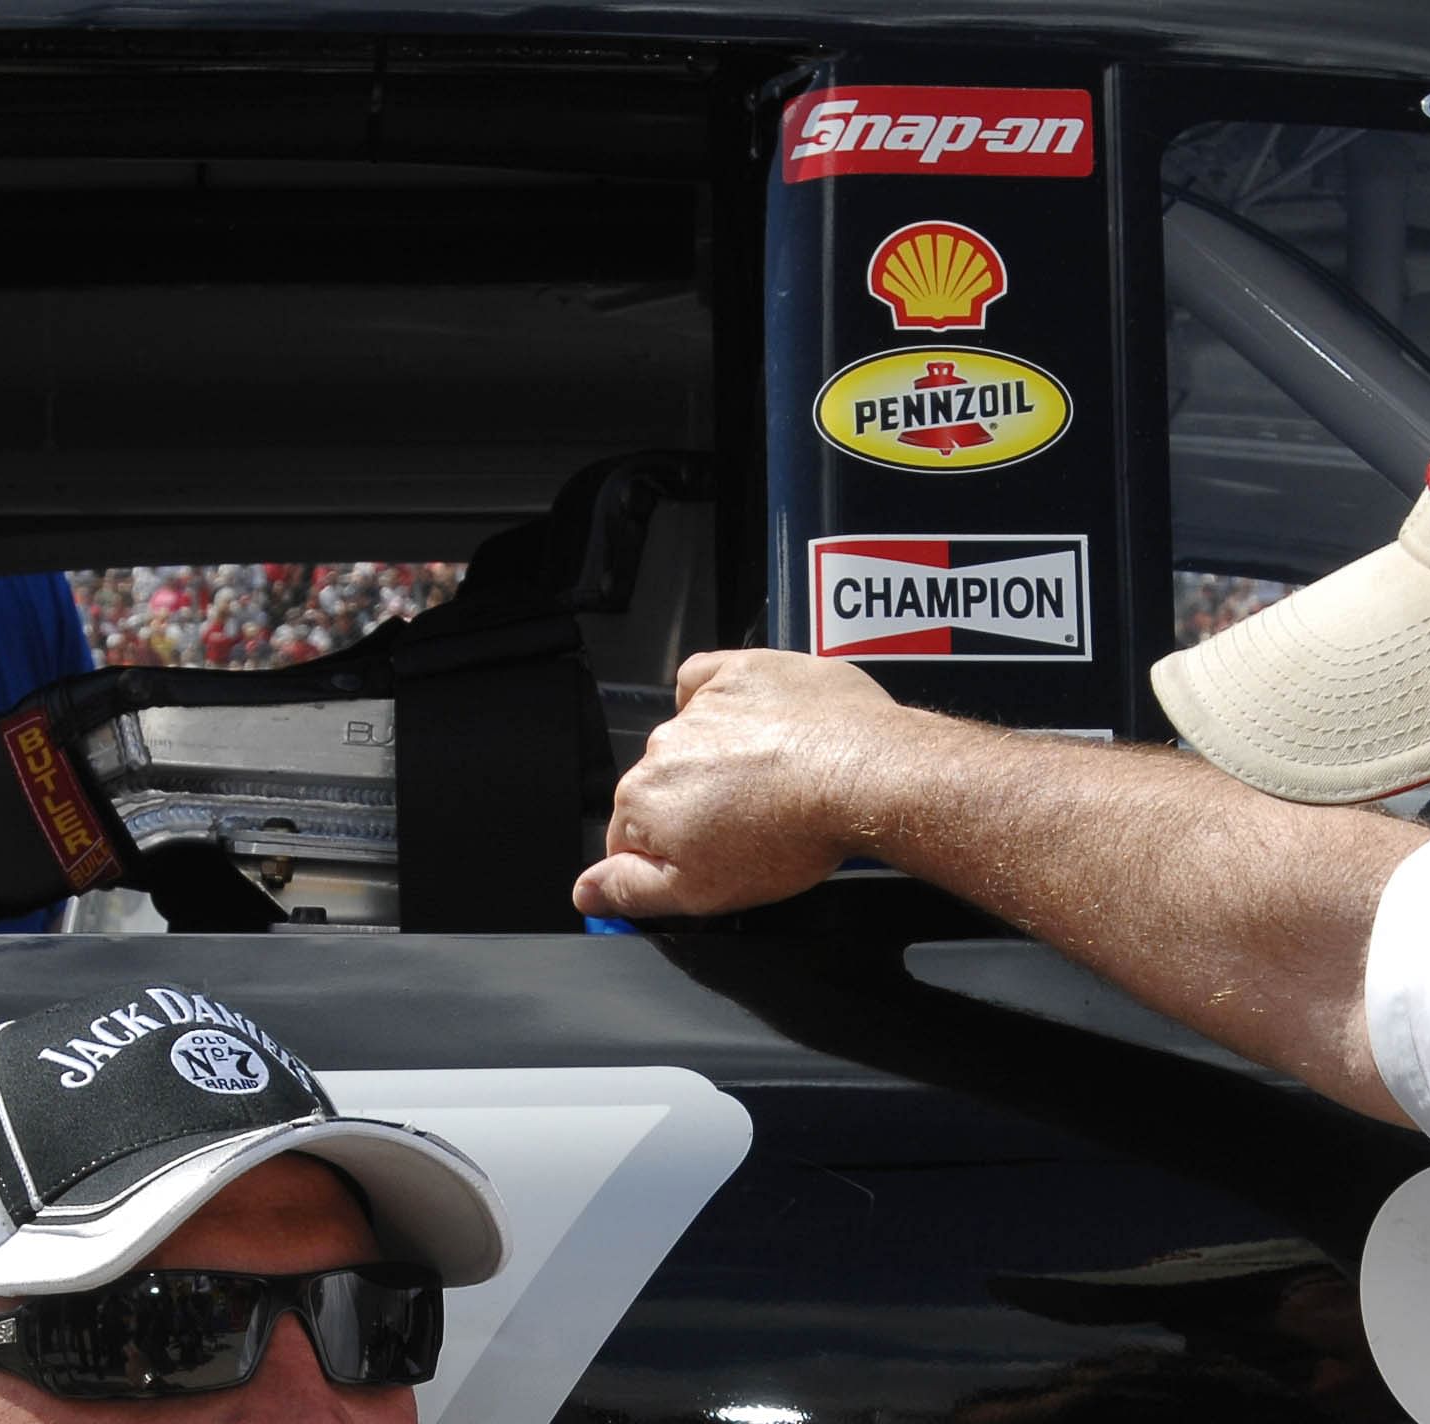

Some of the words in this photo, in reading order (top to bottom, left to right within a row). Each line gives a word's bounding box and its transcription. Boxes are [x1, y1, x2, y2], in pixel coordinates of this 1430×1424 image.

[791, 100, 1085, 163] Snap-on
[854, 379, 1035, 435] PENNZOIL
[832, 576, 1065, 620] CHAMPION
[17, 726, 93, 856] BUTLER
[38, 1002, 165, 1090] JACK
[191, 1036, 226, 1046] OLD
[204, 1078, 259, 1091] BRAND
